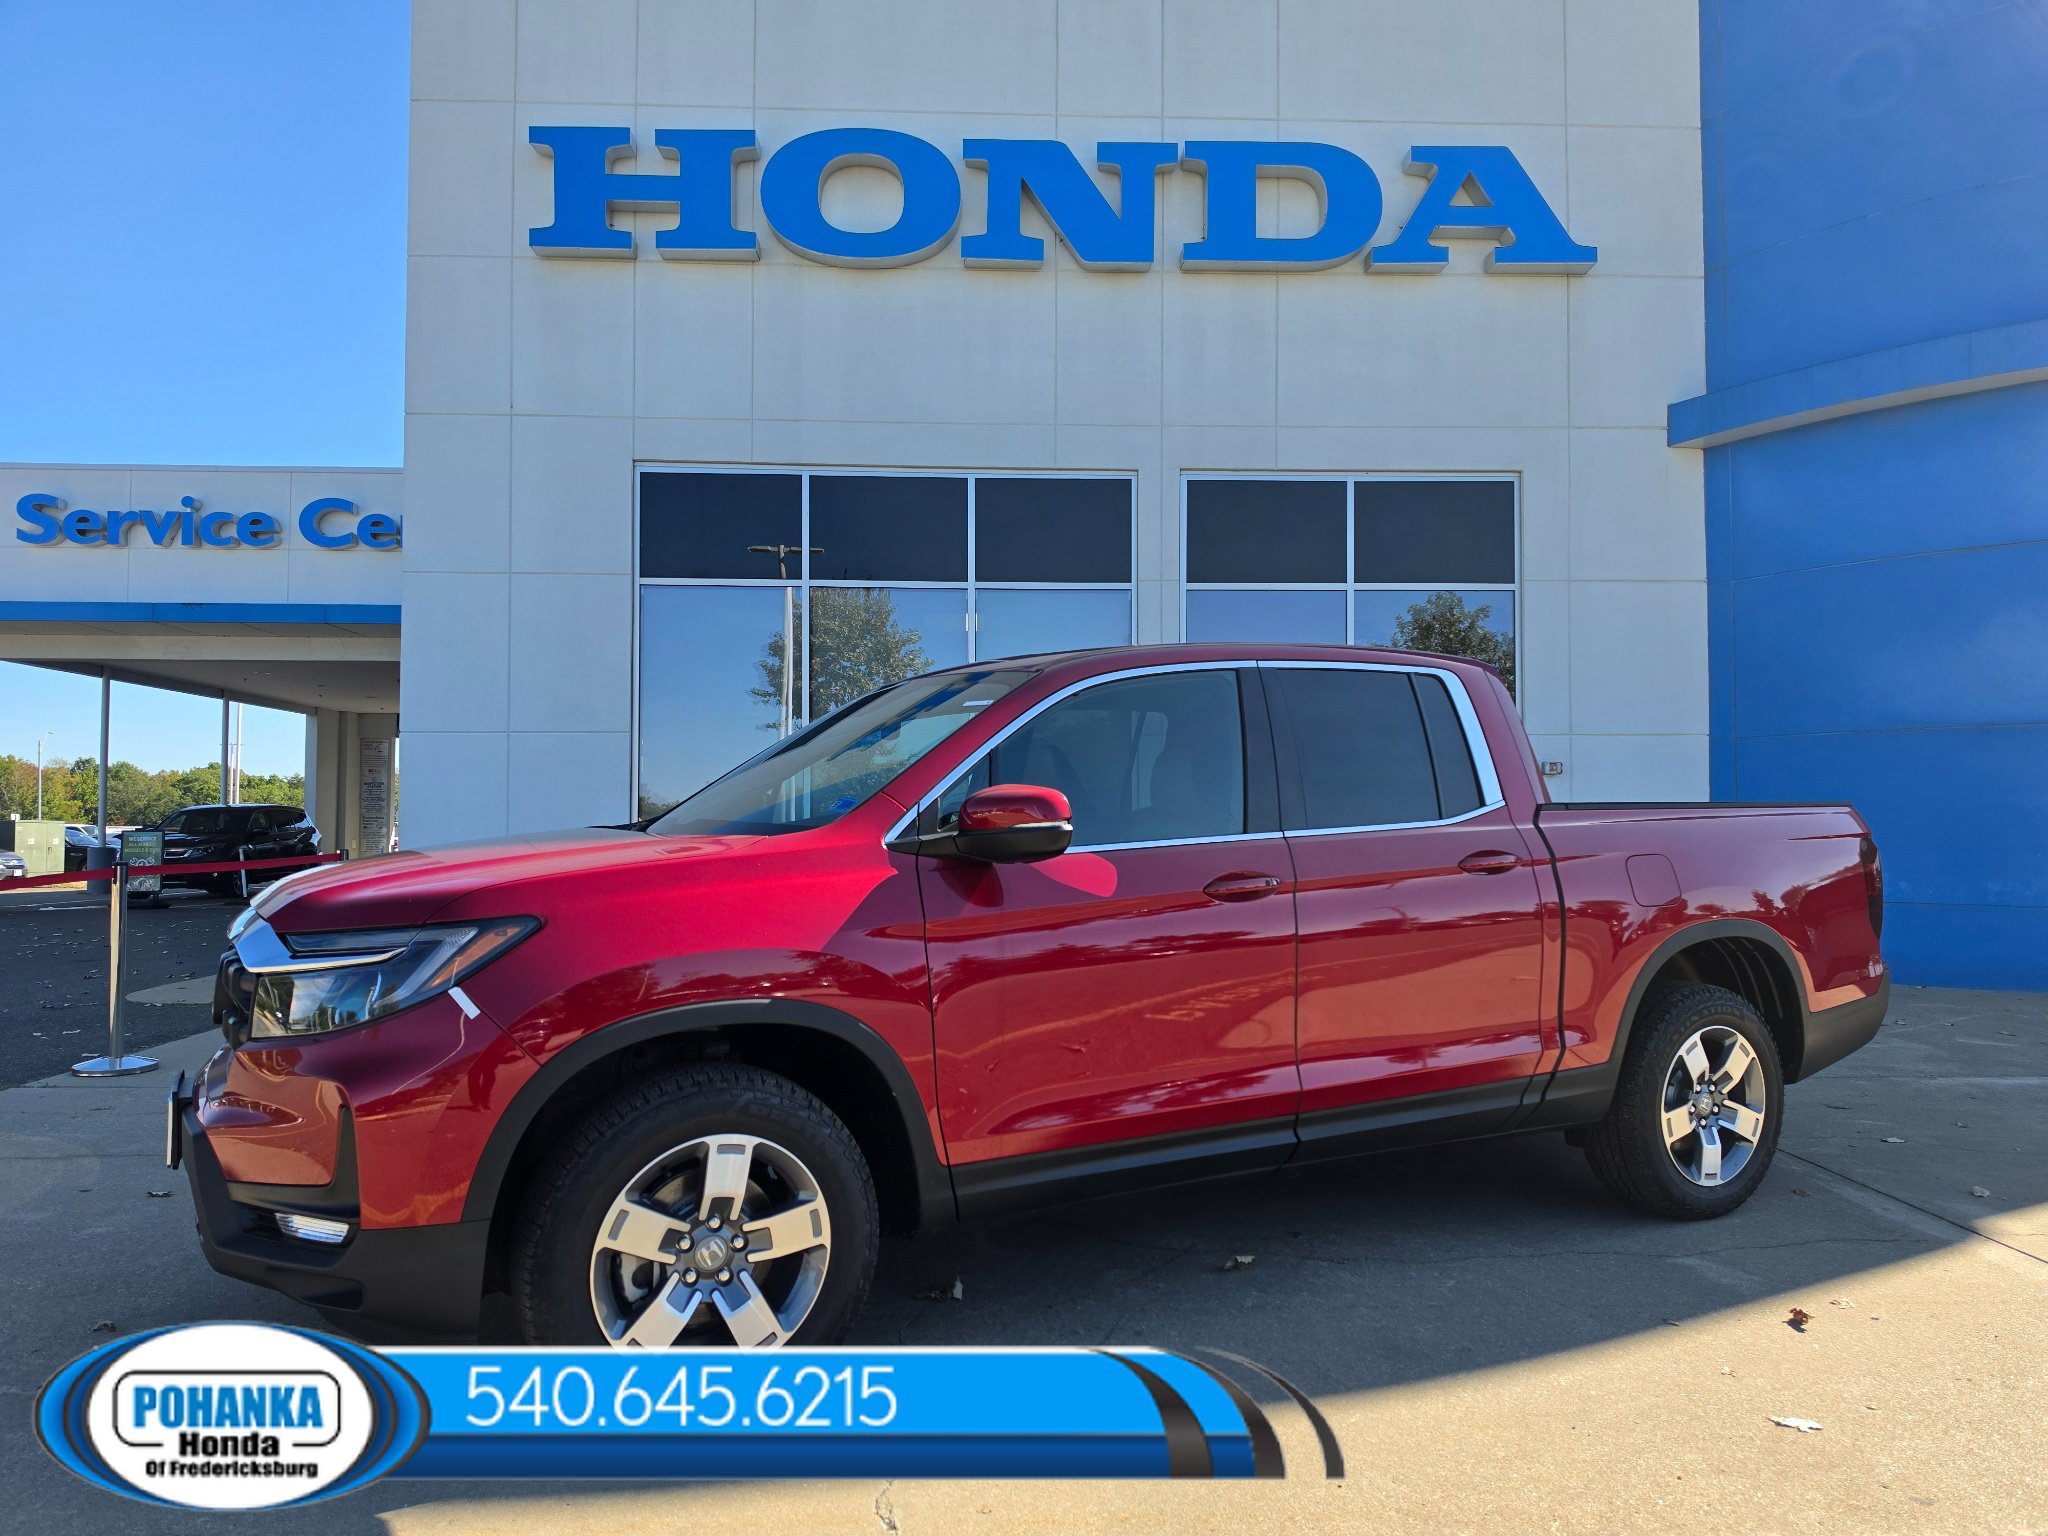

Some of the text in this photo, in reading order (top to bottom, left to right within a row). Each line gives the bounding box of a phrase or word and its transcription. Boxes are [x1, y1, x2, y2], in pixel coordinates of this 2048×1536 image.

[528, 126, 1598, 271] HONDA
[16, 493, 402, 549] Service Ce
